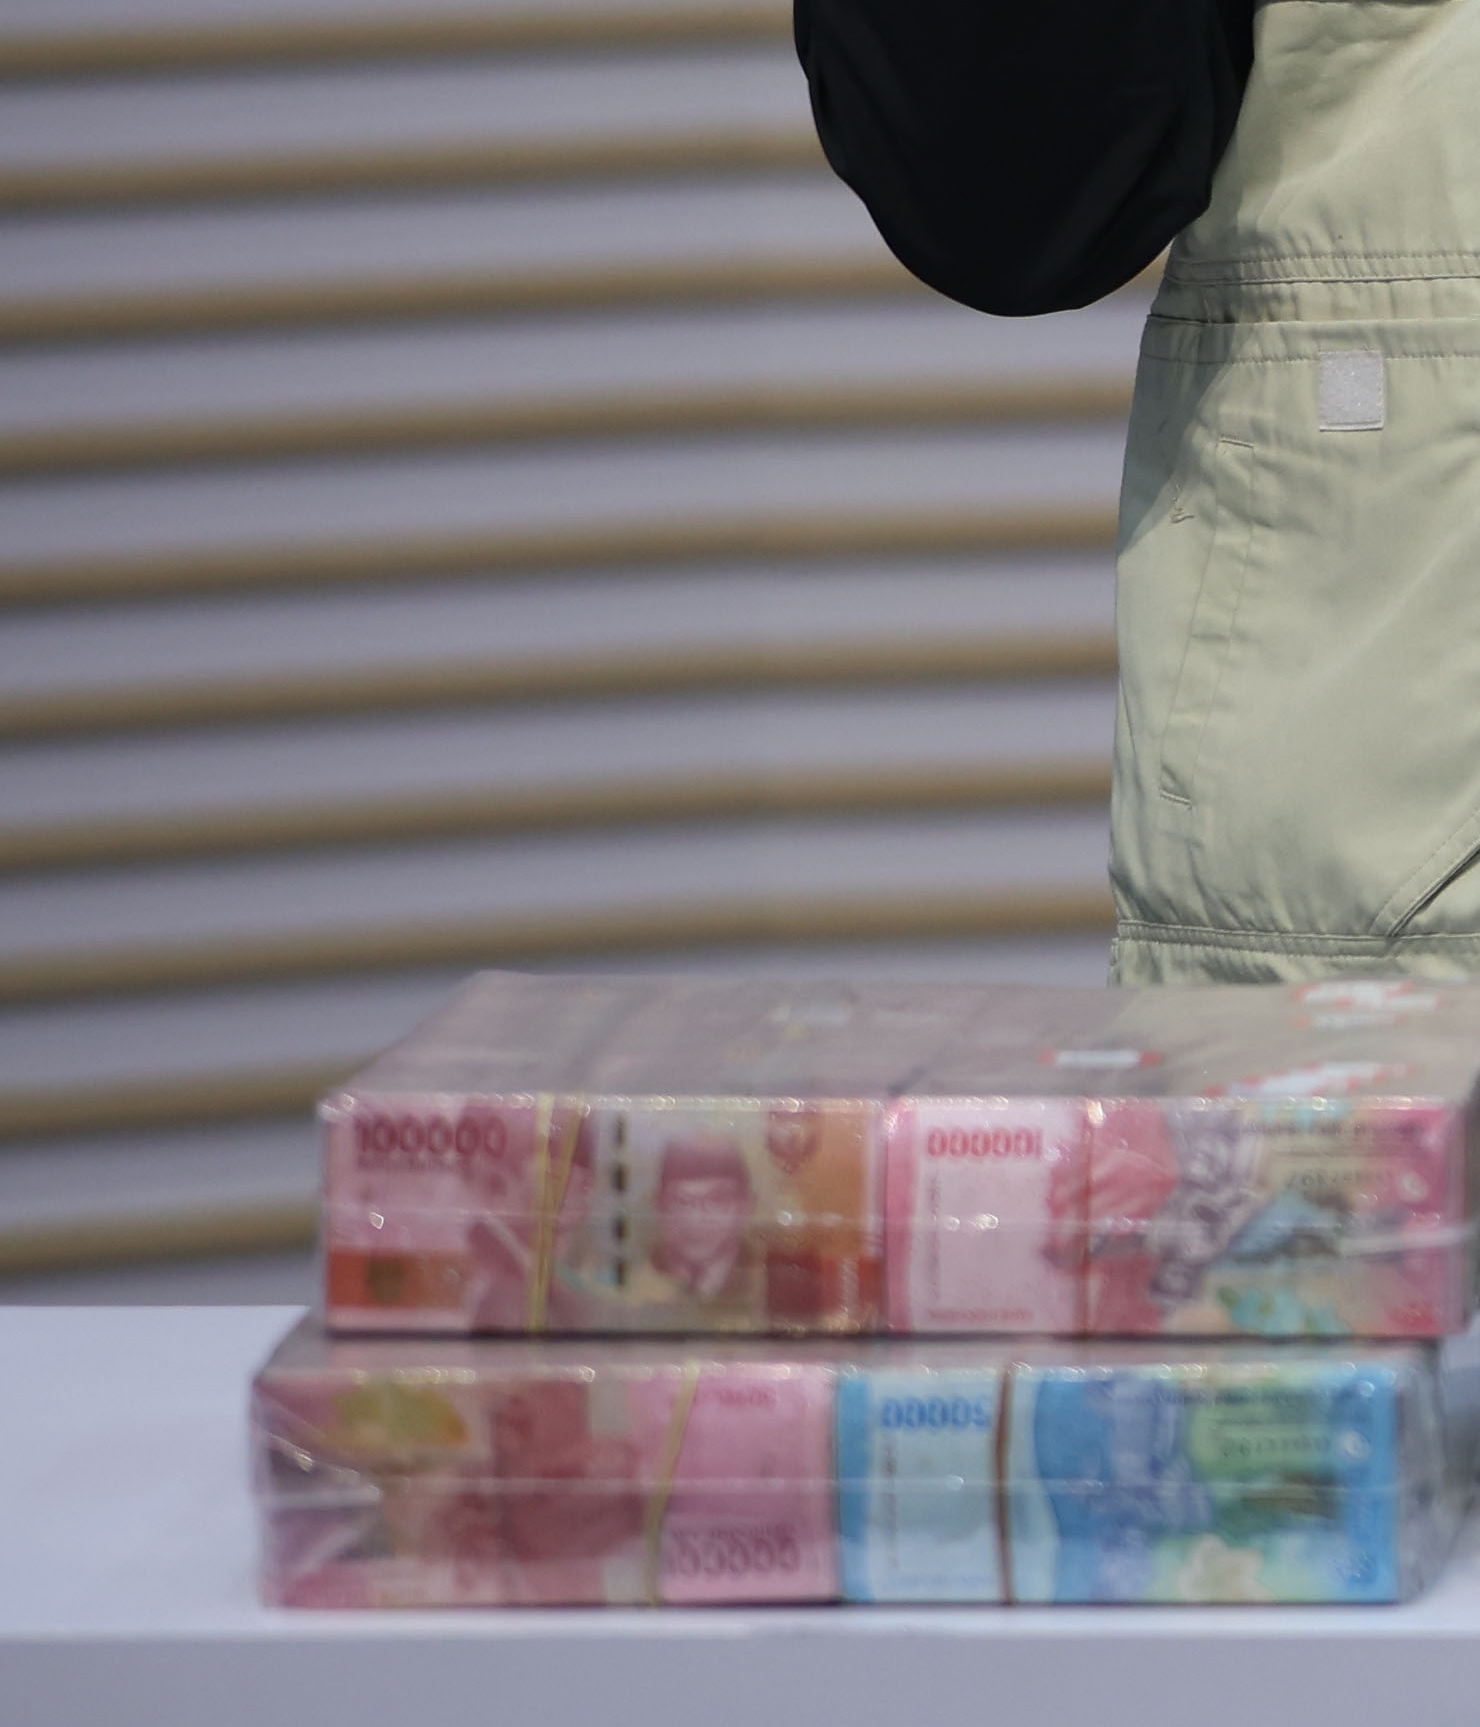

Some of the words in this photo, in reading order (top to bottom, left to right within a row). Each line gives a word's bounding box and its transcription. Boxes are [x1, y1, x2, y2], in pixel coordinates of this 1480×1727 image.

[355, 1114, 508, 1156] 100000
[926, 1126, 1042, 1159] 100000
[880, 1395, 991, 1430] 50000
